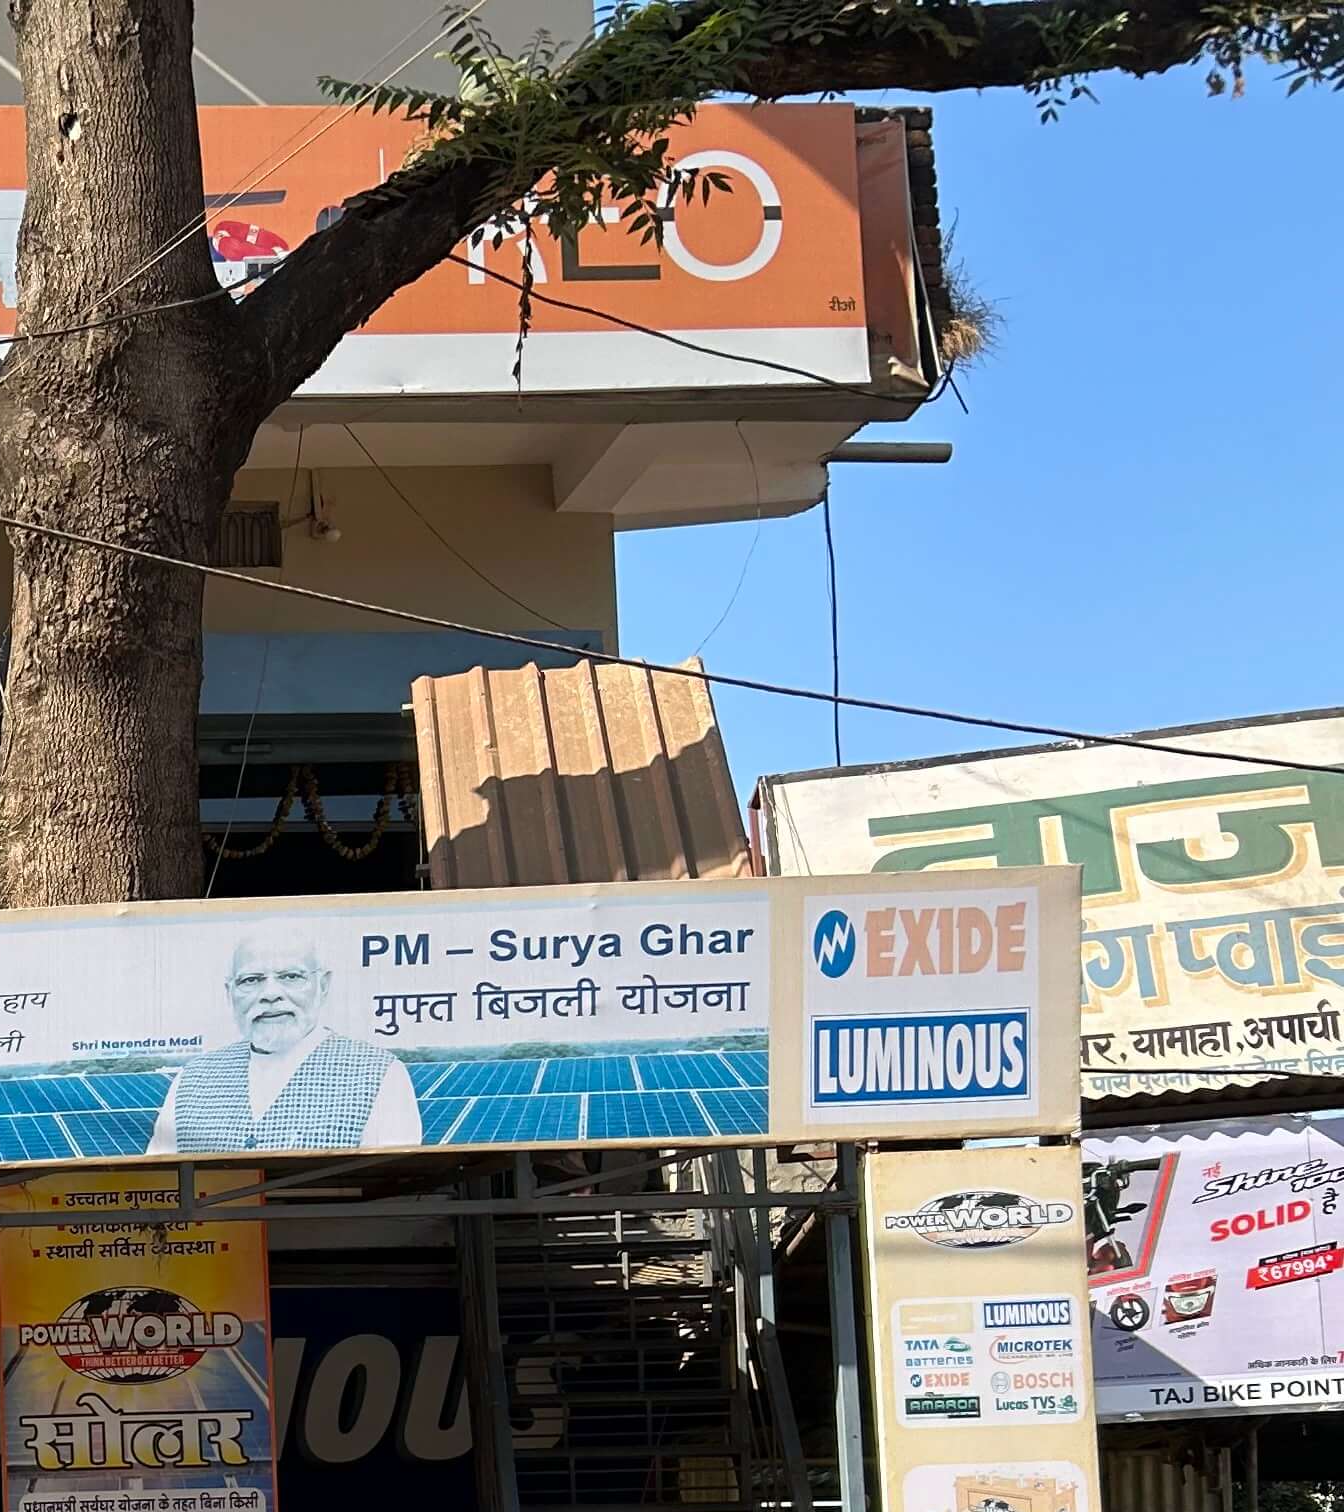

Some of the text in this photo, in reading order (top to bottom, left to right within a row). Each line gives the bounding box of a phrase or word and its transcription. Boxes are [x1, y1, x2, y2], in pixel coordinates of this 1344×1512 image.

[360, 922, 755, 968] PM Surya Ghar
[863, 901, 1028, 979] EXIDE
[372, 974, 752, 1036] मुफ्त बिजली योजना
[72, 1040, 99, 1052] Shri
[101, 1037, 167, 1050] Narendra
[169, 1034, 203, 1048] Modi
[816, 1016, 1025, 1096] LUMINOUS
[1192, 1158, 1329, 1205] Shine
[885, 1203, 1074, 1230] POWER WORLD
[1210, 1199, 1312, 1243] SOLID
[45, 1238, 94, 1260] स्थायी
[98, 1237, 146, 1258] सर्विस
[984, 1302, 1070, 1326] LUMINOUS
[19, 1312, 244, 1349] POWER WORLD
[904, 1339, 940, 1351] TATA
[996, 1338, 1073, 1353] MICROTEK
[924, 1372, 971, 1388] EXIDE
[1013, 1372, 1074, 1390] BOSCH
[1150, 1378, 1344, 1406] TAJ BIKE POINT
[996, 1395, 1056, 1411] Lucas TVS
[19, 1391, 254, 1472] सोलर
[118, 1494, 155, 1511] योजना
[158, 1493, 170, 1510] के
[172, 1495, 196, 1510] तहत
[199, 1492, 226, 1510] बिना
[228, 1491, 259, 1509] किसी
